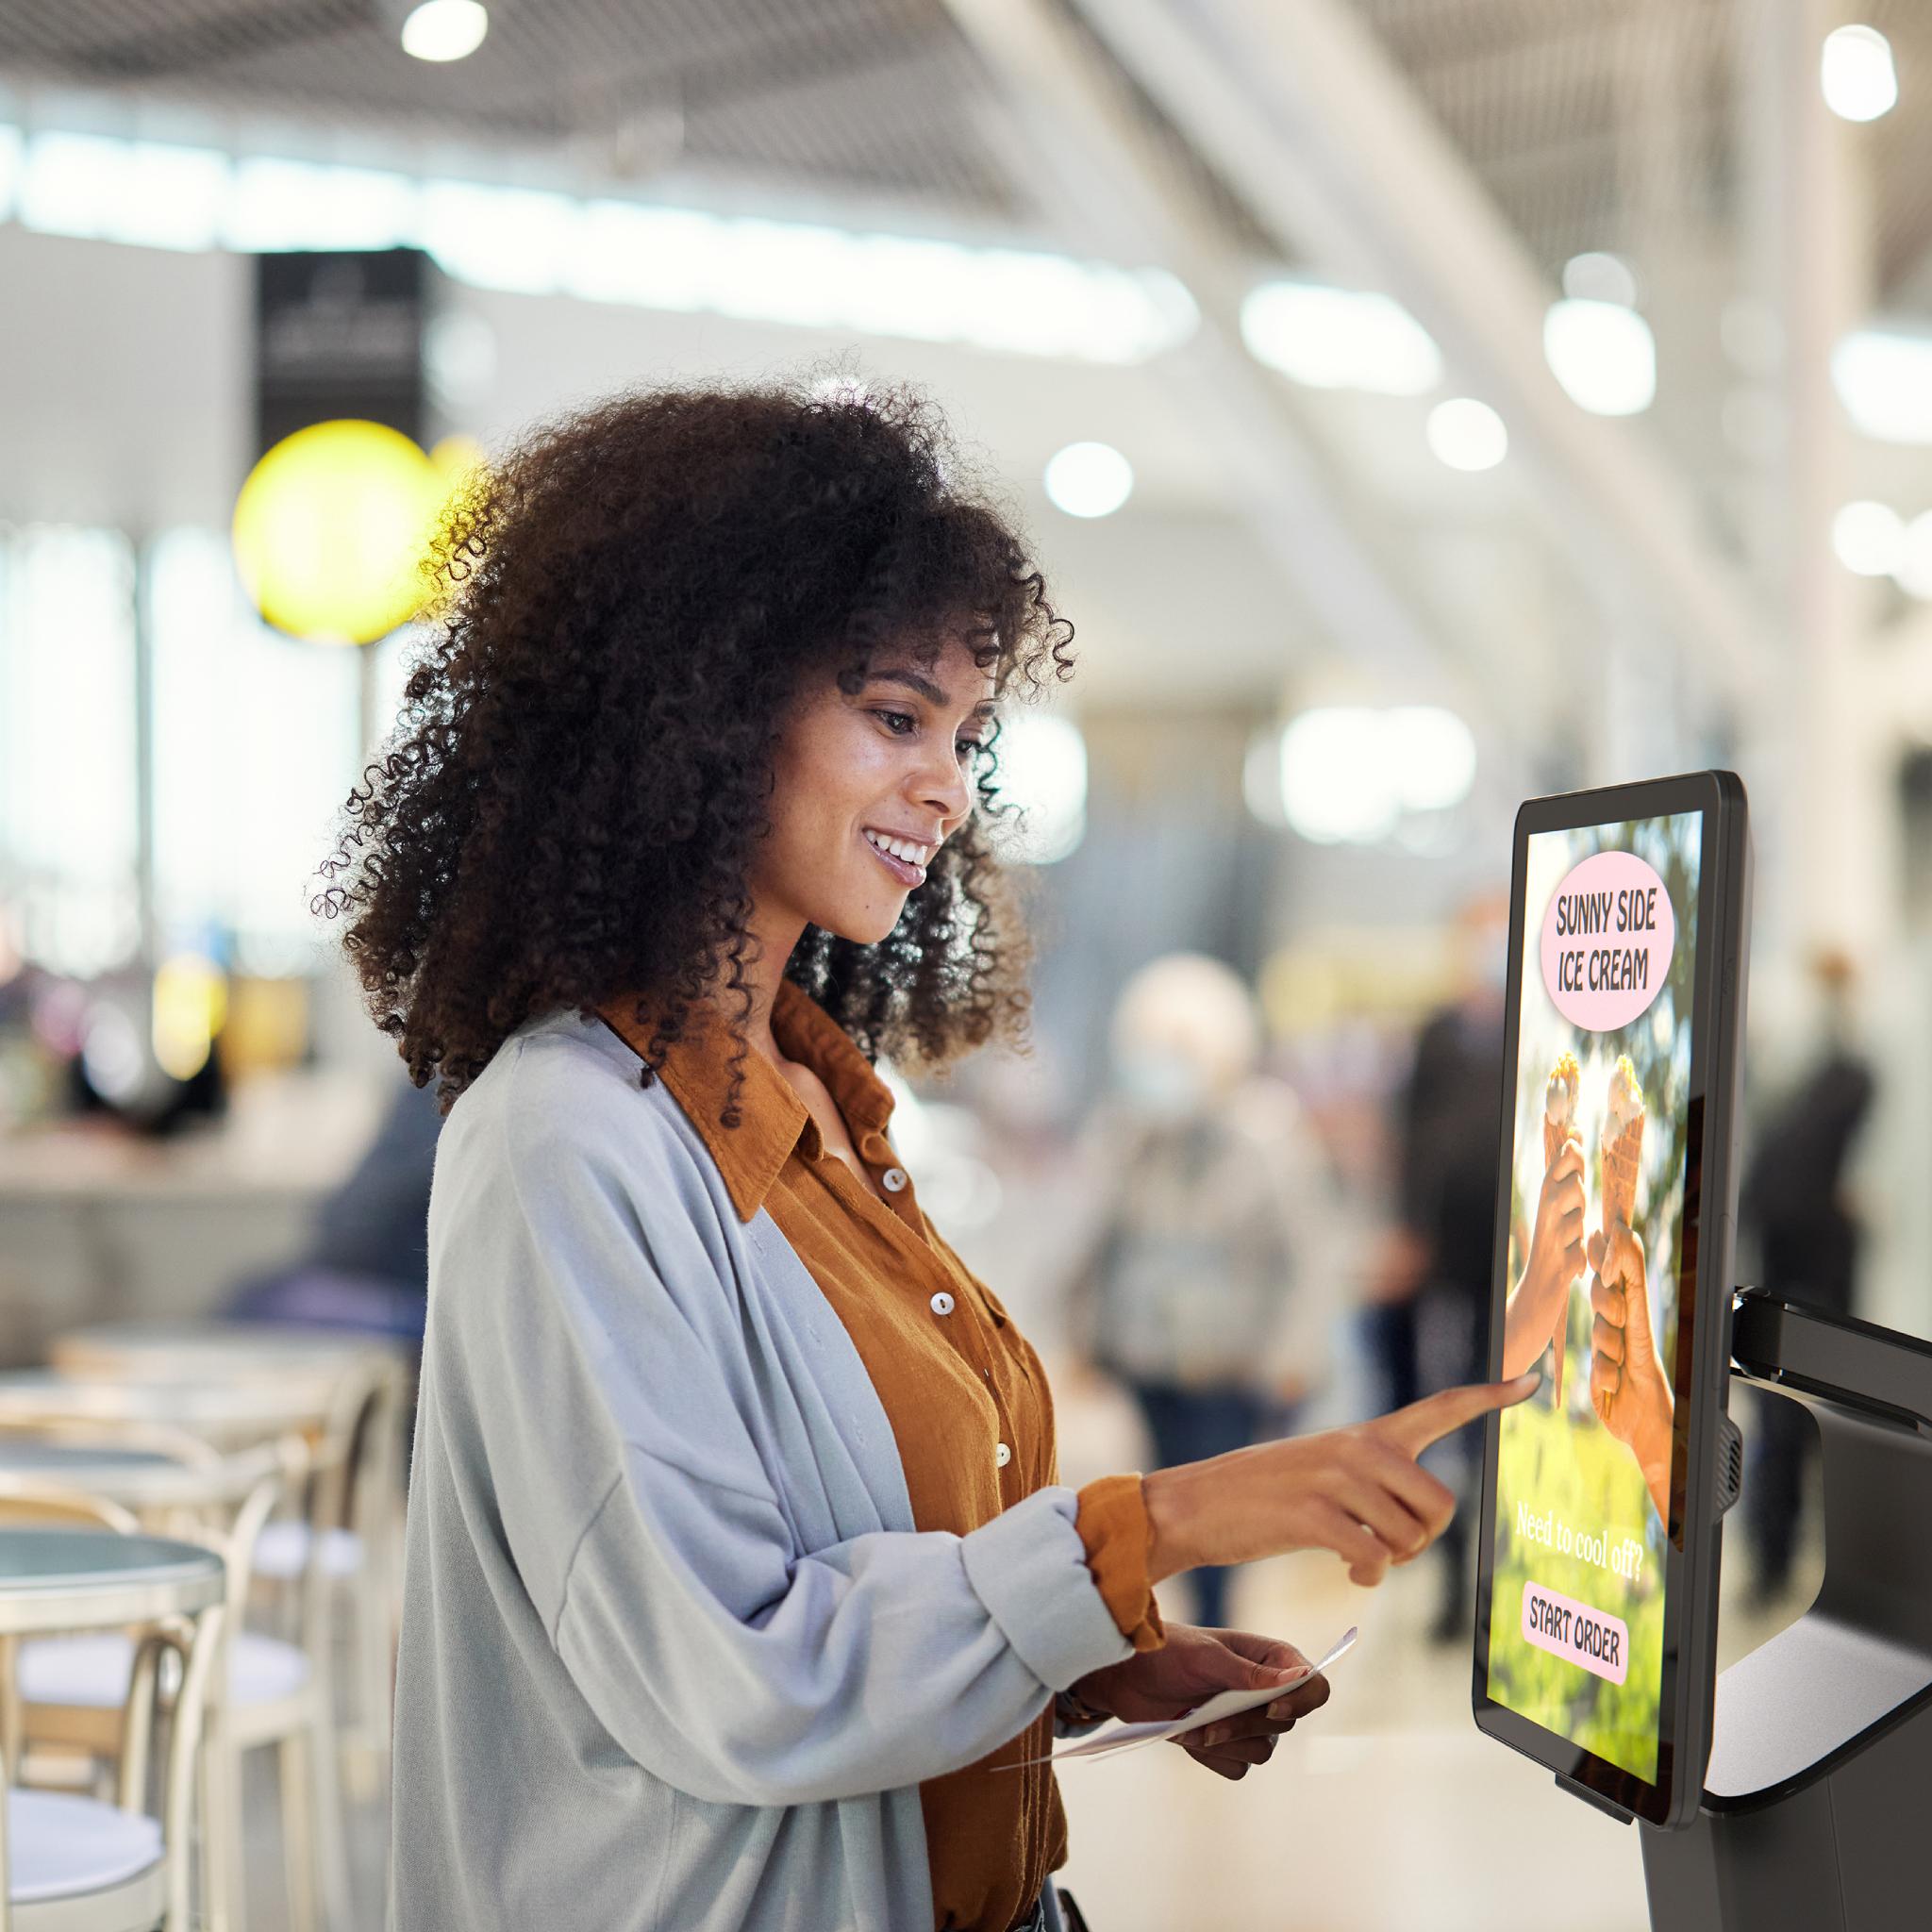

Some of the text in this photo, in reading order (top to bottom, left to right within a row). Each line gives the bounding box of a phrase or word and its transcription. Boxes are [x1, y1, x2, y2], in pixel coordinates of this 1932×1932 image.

[1557, 888, 1657, 936] SUNNY SIDE
[1558, 947, 1648, 991] ICE CREAM
[1516, 1501, 1643, 1582] Need to cool off?
[1529, 1595, 1620, 1667] START ORDER
